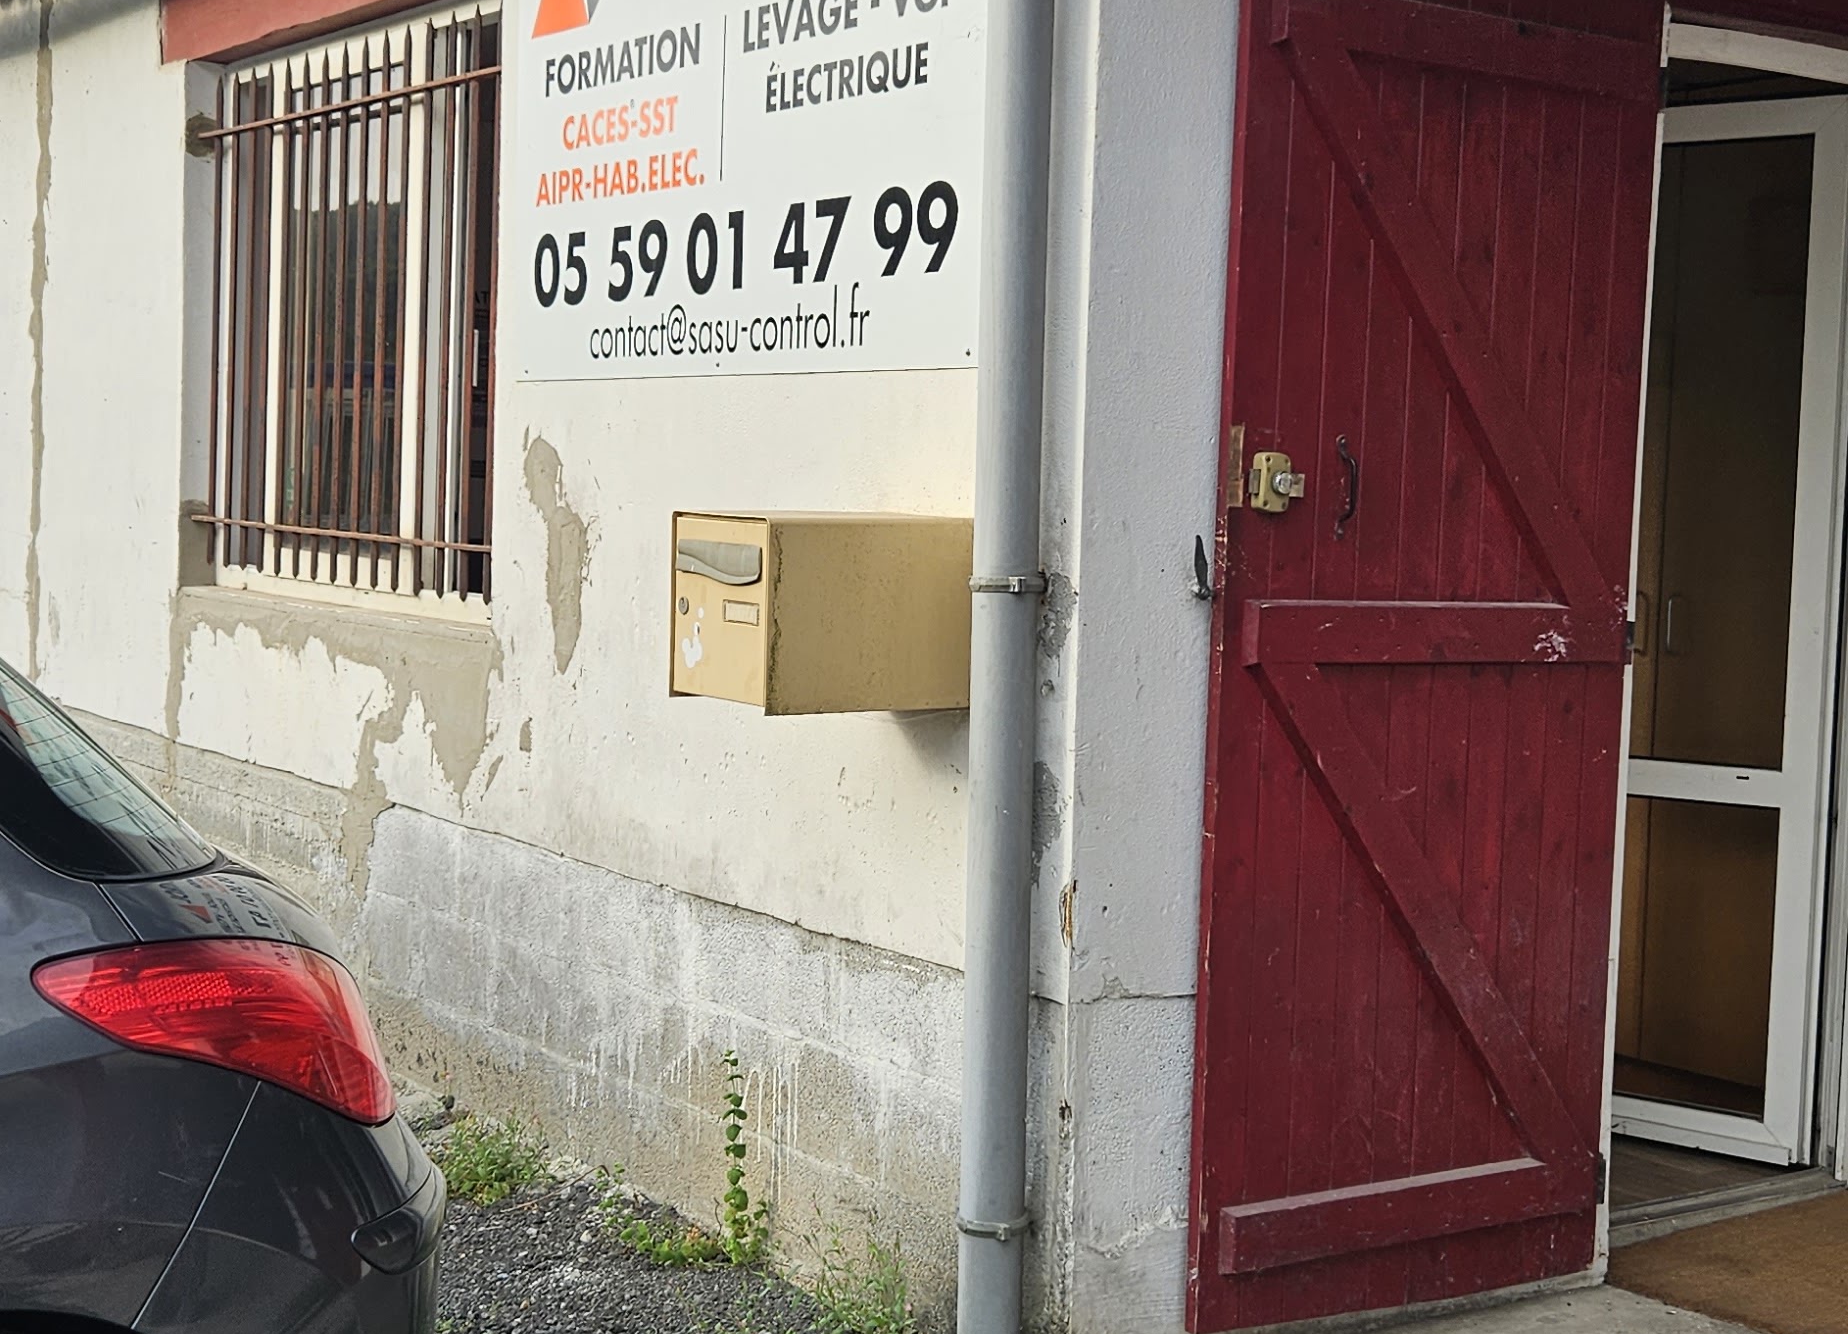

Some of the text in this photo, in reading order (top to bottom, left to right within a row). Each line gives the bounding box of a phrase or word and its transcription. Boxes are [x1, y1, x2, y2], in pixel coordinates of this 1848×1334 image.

[545, 22, 701, 98] FORMATION
[765, 41, 930, 114] ÉLECTRIQUE
[535, 148, 705, 208] AIPR-HAB.ELEC.
[533, 180, 959, 309] 05 59 01 47 99
[589, 282, 871, 360] contact@sasu-control.fr
